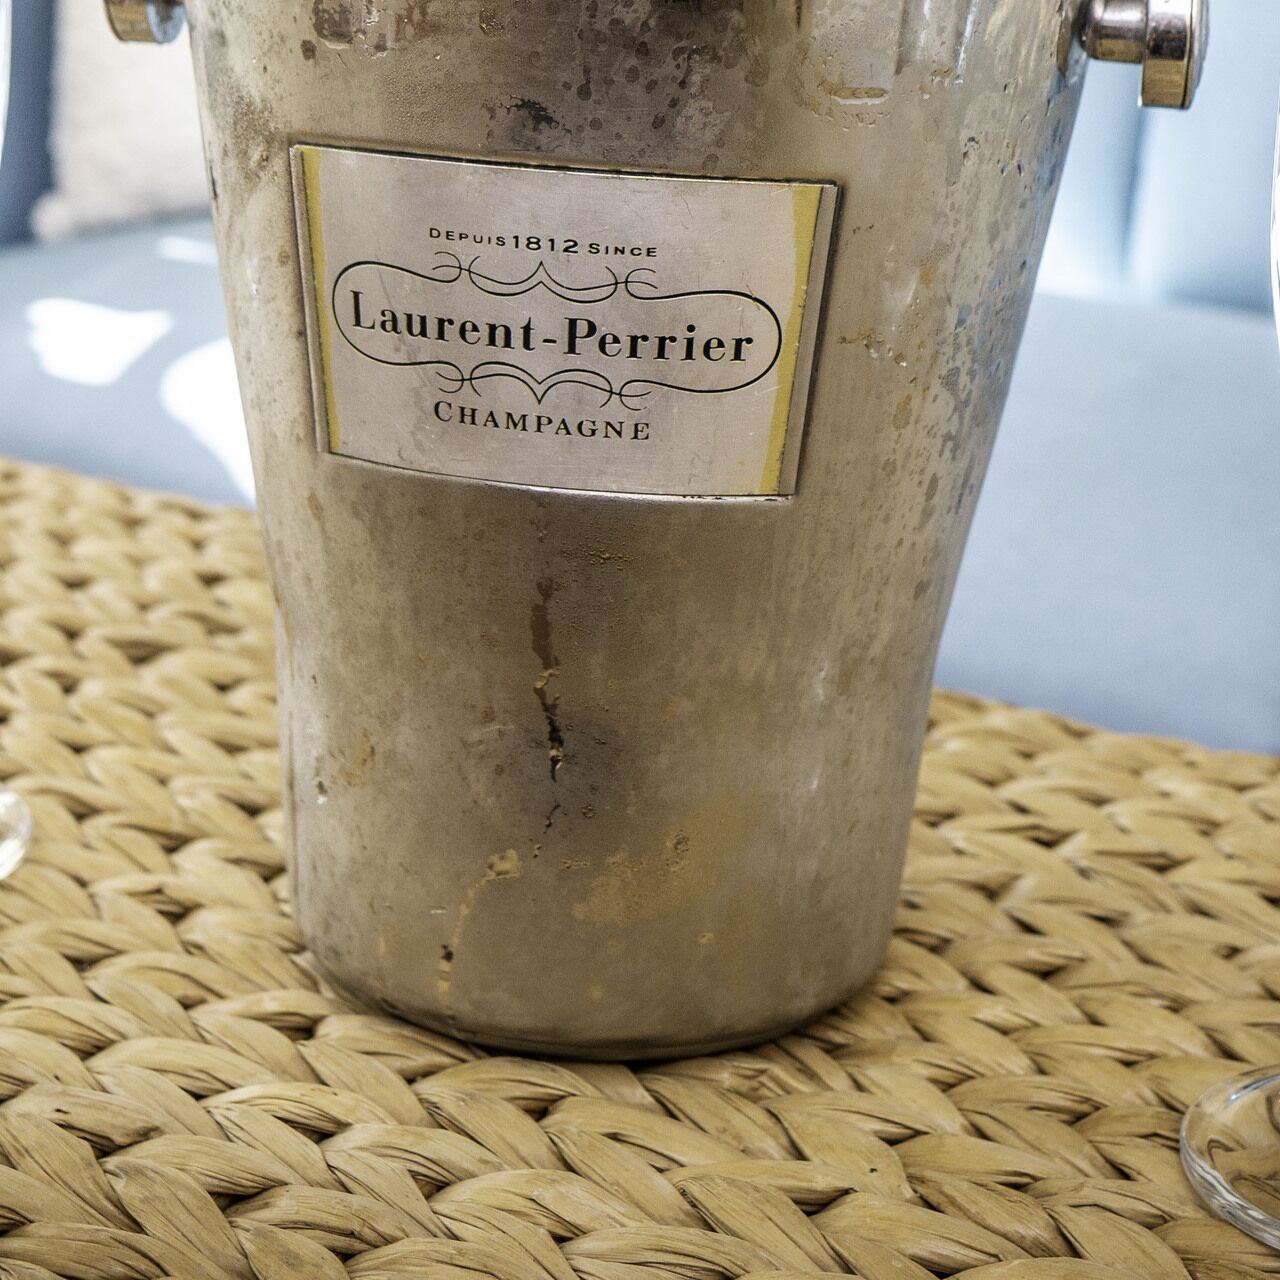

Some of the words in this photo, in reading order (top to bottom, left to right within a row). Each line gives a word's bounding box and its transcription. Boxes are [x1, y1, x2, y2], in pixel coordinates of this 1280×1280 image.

[429, 227, 506, 247] DEPUIS
[512, 234, 579, 254] 1812
[587, 242, 658, 258] SINCE
[349, 289, 754, 362] Laurent-Perrier
[433, 400, 650, 441] CHAMPAGNE
